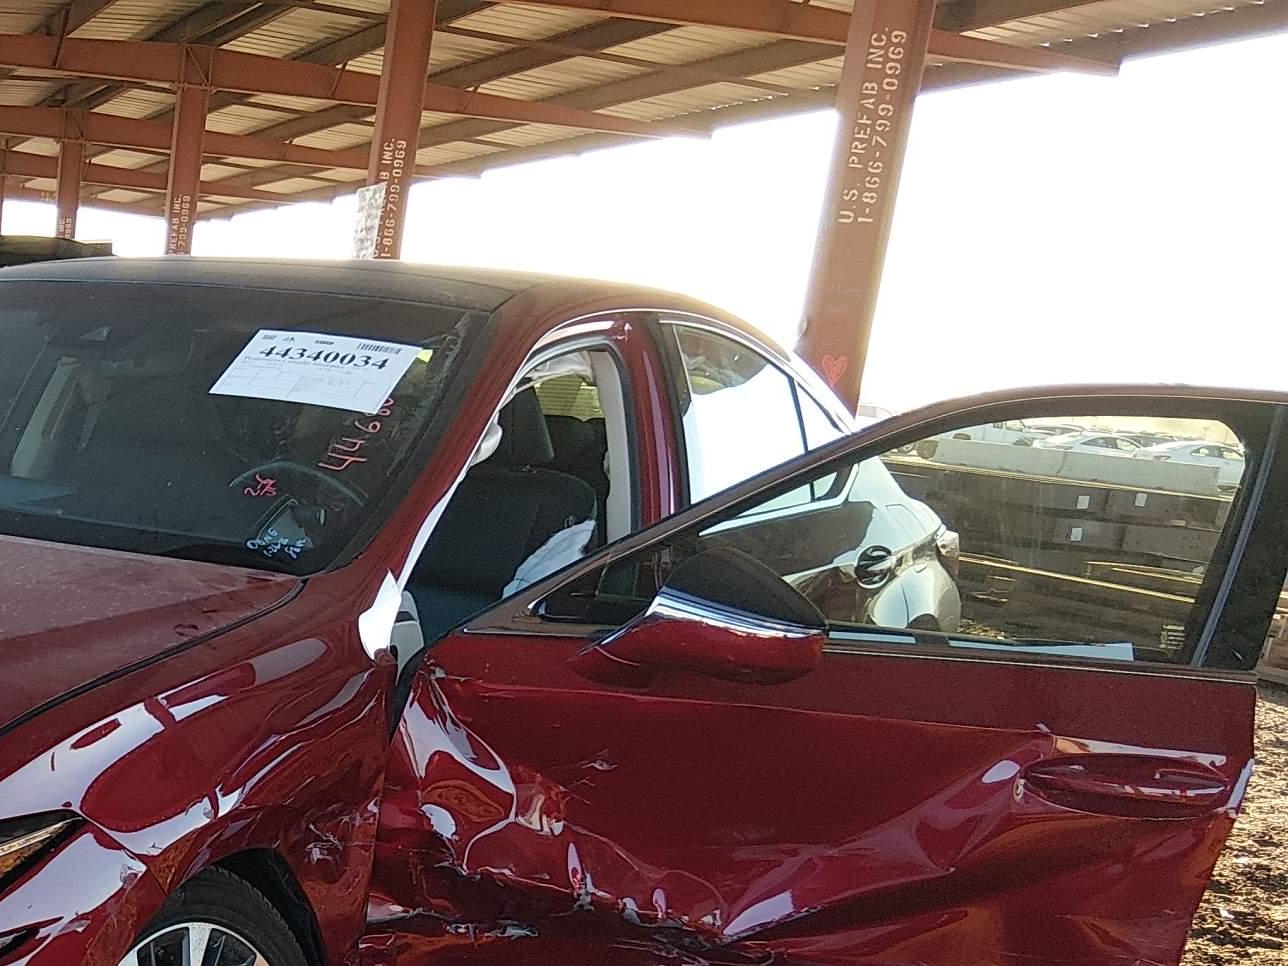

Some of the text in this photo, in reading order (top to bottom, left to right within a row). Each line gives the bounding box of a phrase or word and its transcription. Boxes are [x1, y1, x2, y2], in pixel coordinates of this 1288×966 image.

[381, 138, 395, 164] INC.
[838, 27, 889, 224] U.S. PREFAB INC.
[857, 30, 907, 223] 1-866-799-0969
[380, 140, 407, 257] 1-866-799-0969
[259, 345, 390, 370] 44340034
